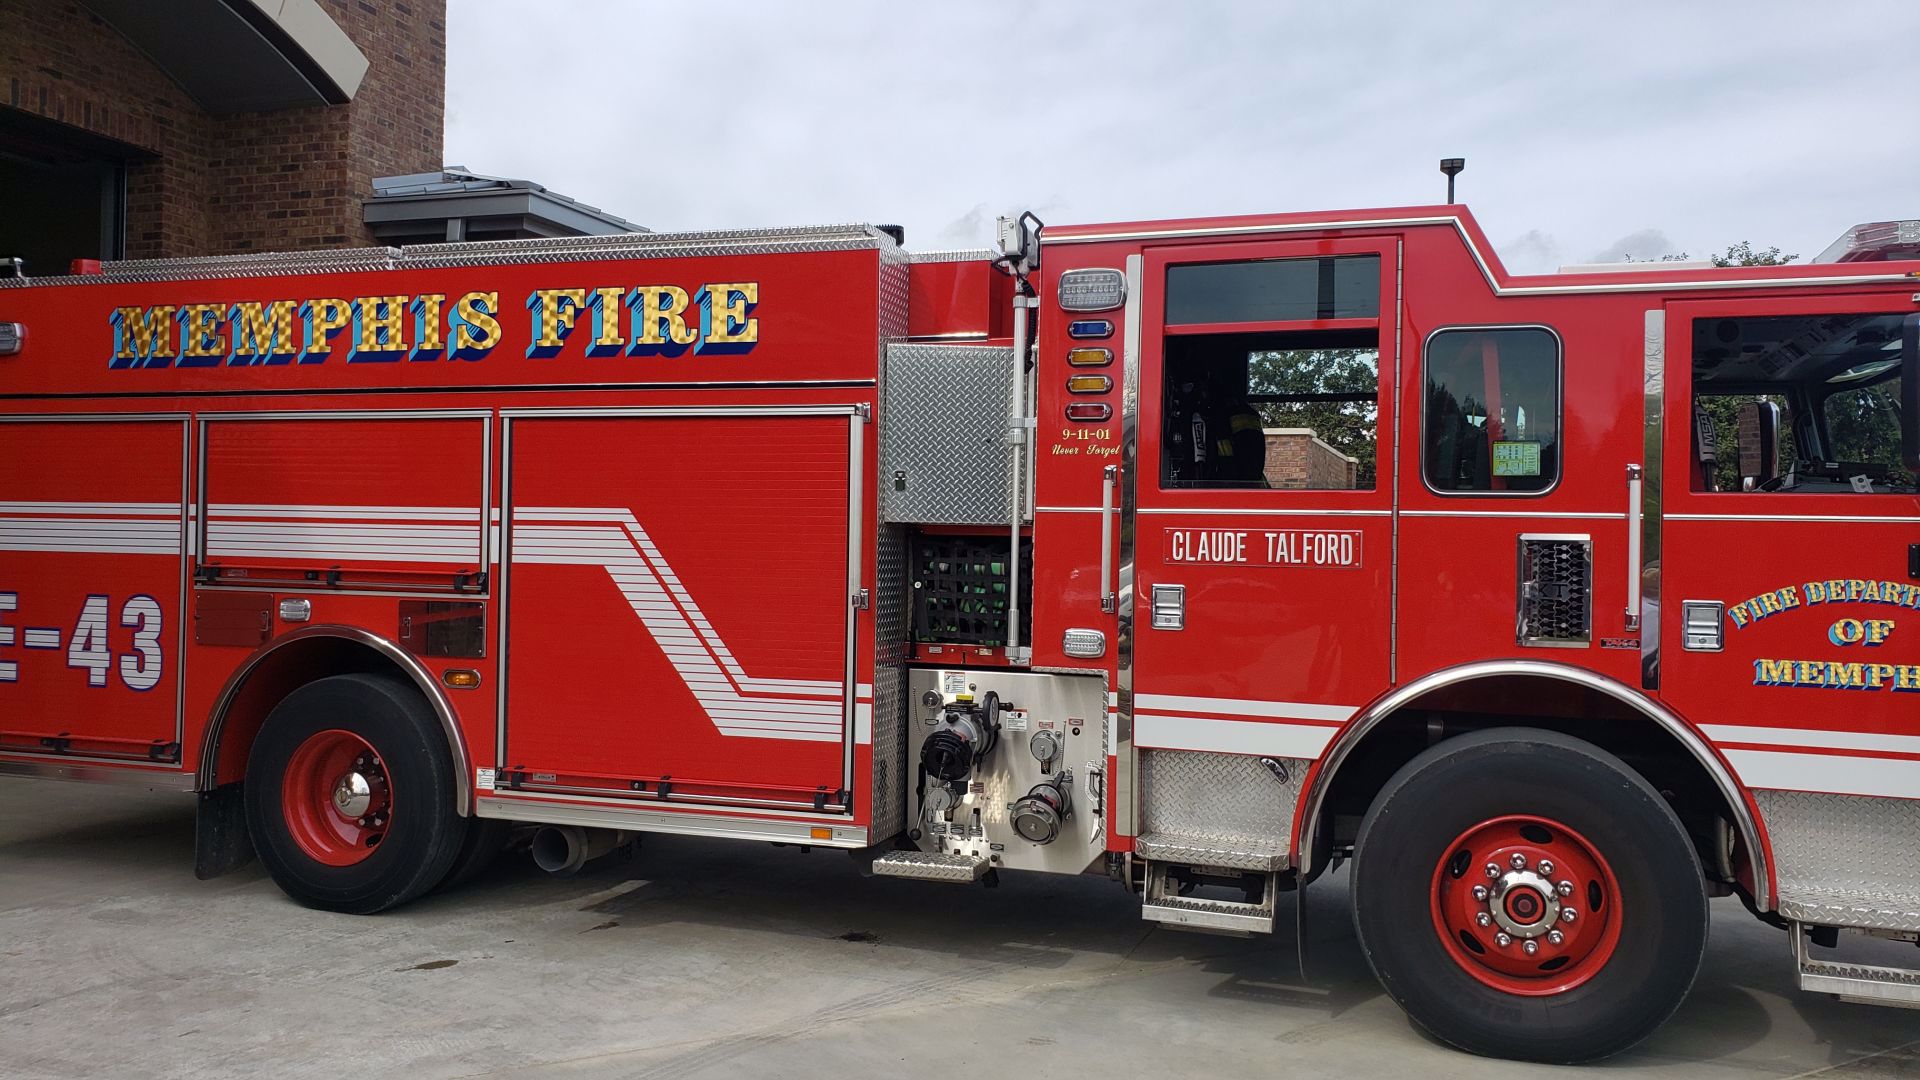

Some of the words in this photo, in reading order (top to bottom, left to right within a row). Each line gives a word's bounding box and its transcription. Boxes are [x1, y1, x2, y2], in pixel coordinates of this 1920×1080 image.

[108, 290, 502, 369] MEMPHIS
[525, 281, 759, 360] FIRE
[1062, 428, 1110, 441] 9-11-01
[1052, 444, 1079, 455] Never
[1086, 444, 1120, 459] Forget
[1172, 531, 1247, 562] CLAUDE
[1264, 532, 1353, 566] TALFORD
[1728, 585, 1801, 630] FIRE
[1802, 579, 1920, 612] DEPART
[1828, 618, 1895, 647] OF
